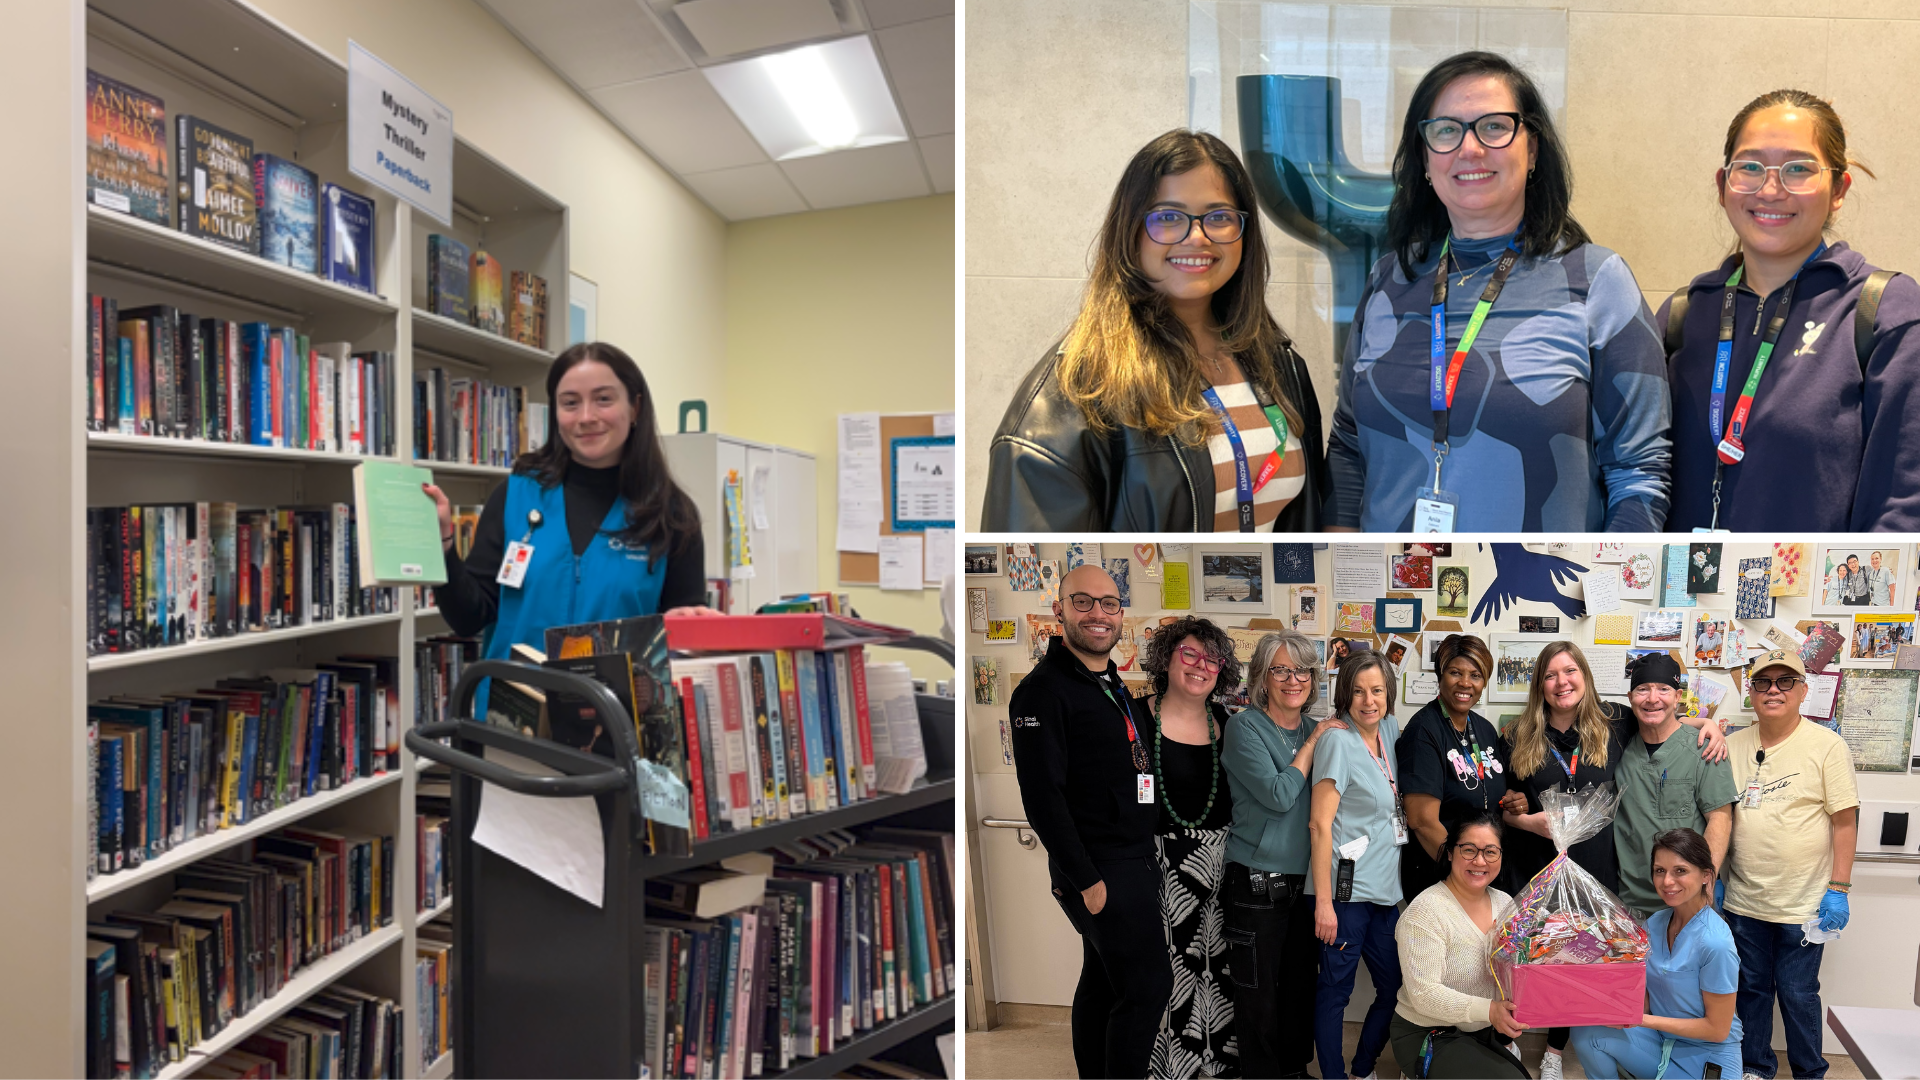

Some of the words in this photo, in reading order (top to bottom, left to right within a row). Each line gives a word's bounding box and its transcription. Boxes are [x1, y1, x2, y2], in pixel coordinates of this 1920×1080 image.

[94, 84, 155, 124] ANNE
[382, 89, 429, 135] Mystery
[92, 103, 159, 145] PERRY
[383, 122, 426, 162] Thriller
[376, 150, 431, 194] Paperback
[205, 188, 245, 217] AIMEE
[199, 212, 252, 243] MOLLOY
[1715, 362, 1723, 389] INCLUSIVITY
[1753, 355, 1766, 380] HUMANITY
[1238, 461, 1248, 491] DISCOVERY
[1259, 462, 1275, 484] SERVICE
[121, 511, 129, 545] TONY
[123, 549, 132, 609] PARSONS
[1635, 563, 1651, 571] Thank
[1640, 571, 1649, 579] you
[317, 693, 327, 727] RANKIN
[153, 717, 161, 747] ANNE
[153, 749, 161, 779] PERRY
[114, 807, 122, 852] PENNY
[780, 913, 788, 978] GREANEY
[787, 927, 795, 965] MARK
